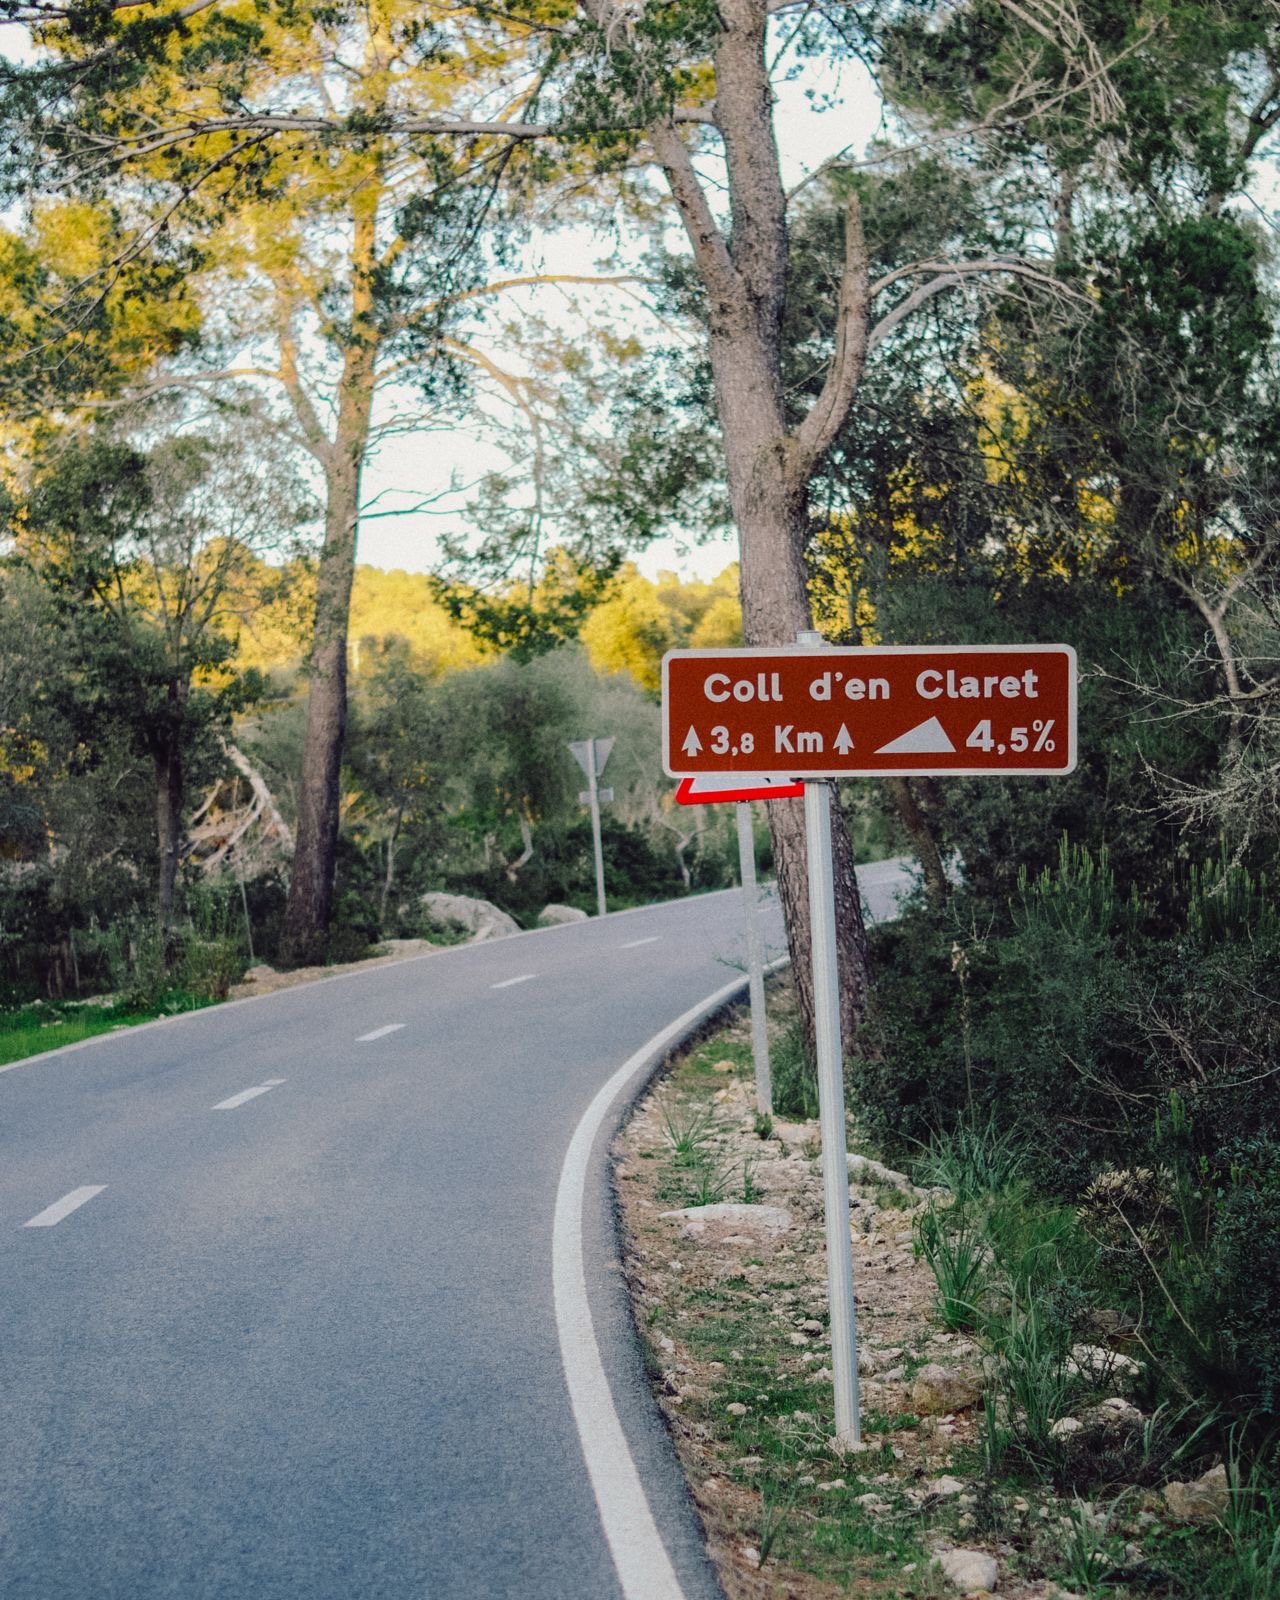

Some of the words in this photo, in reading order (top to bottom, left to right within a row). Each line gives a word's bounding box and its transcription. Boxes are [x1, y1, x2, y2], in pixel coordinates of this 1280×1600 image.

[703, 672, 784, 703] Coll
[809, 671, 890, 701] d'en
[915, 669, 1039, 699] Claret
[710, 725, 755, 756] 3,8
[774, 725, 824, 753] Km
[965, 719, 1056, 755] 4,5%
